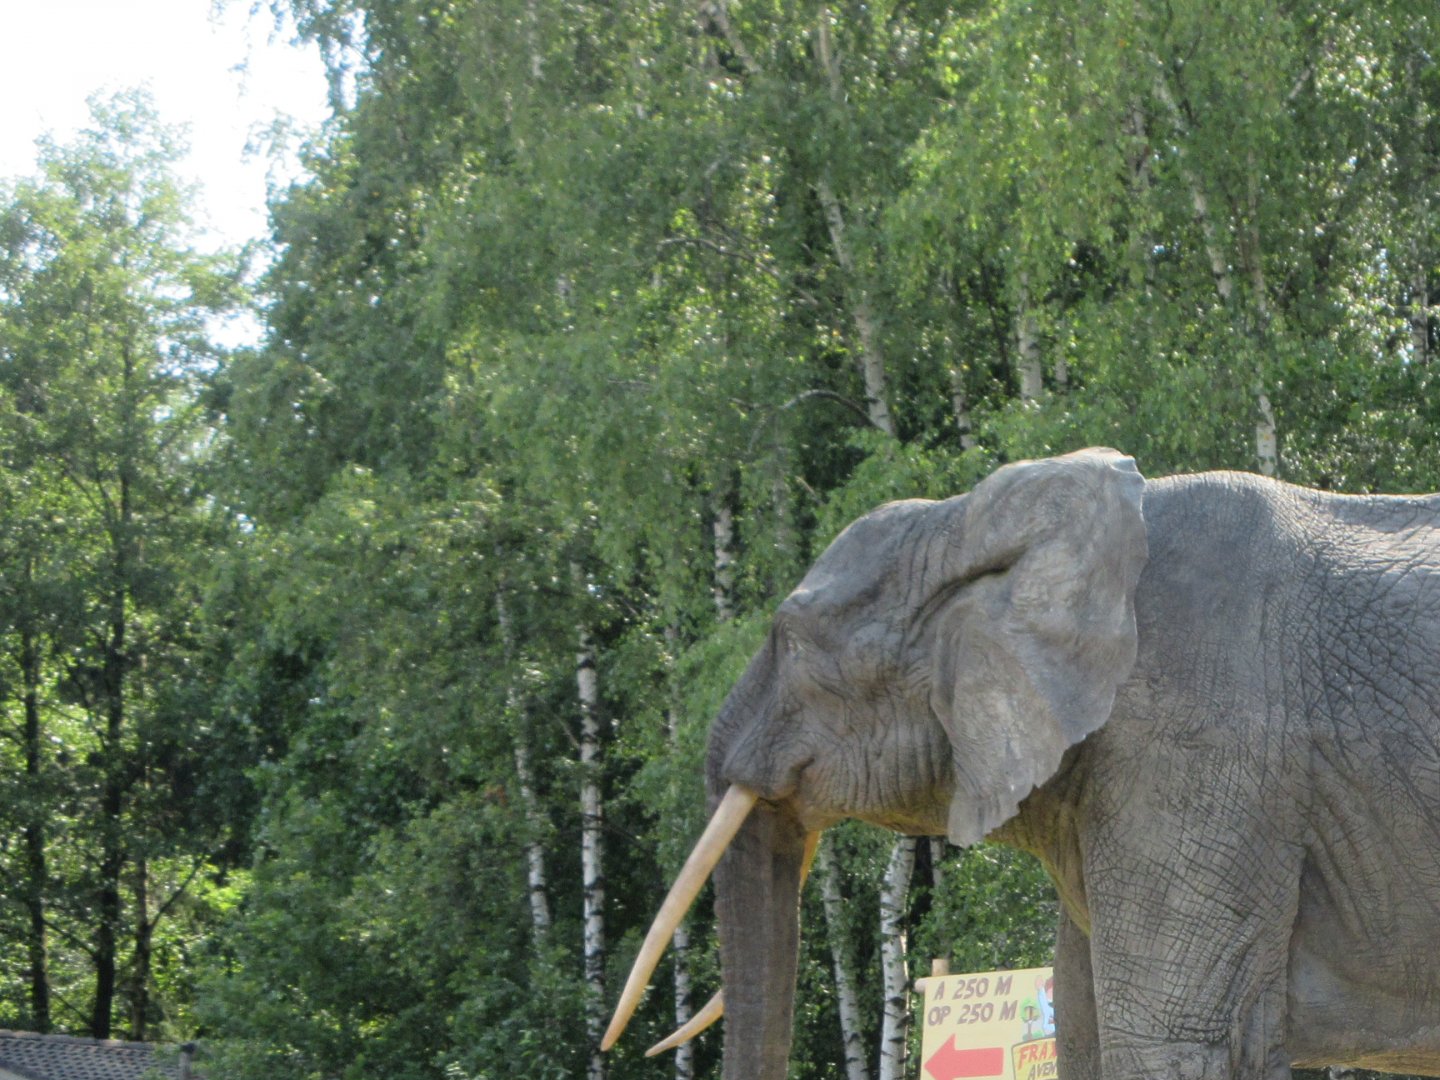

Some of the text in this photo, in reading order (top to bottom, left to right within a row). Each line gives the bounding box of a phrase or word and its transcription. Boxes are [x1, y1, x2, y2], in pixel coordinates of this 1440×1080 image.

[934, 974, 1013, 1001] A 250 M
[927, 999, 1018, 1027] OP 250 M
